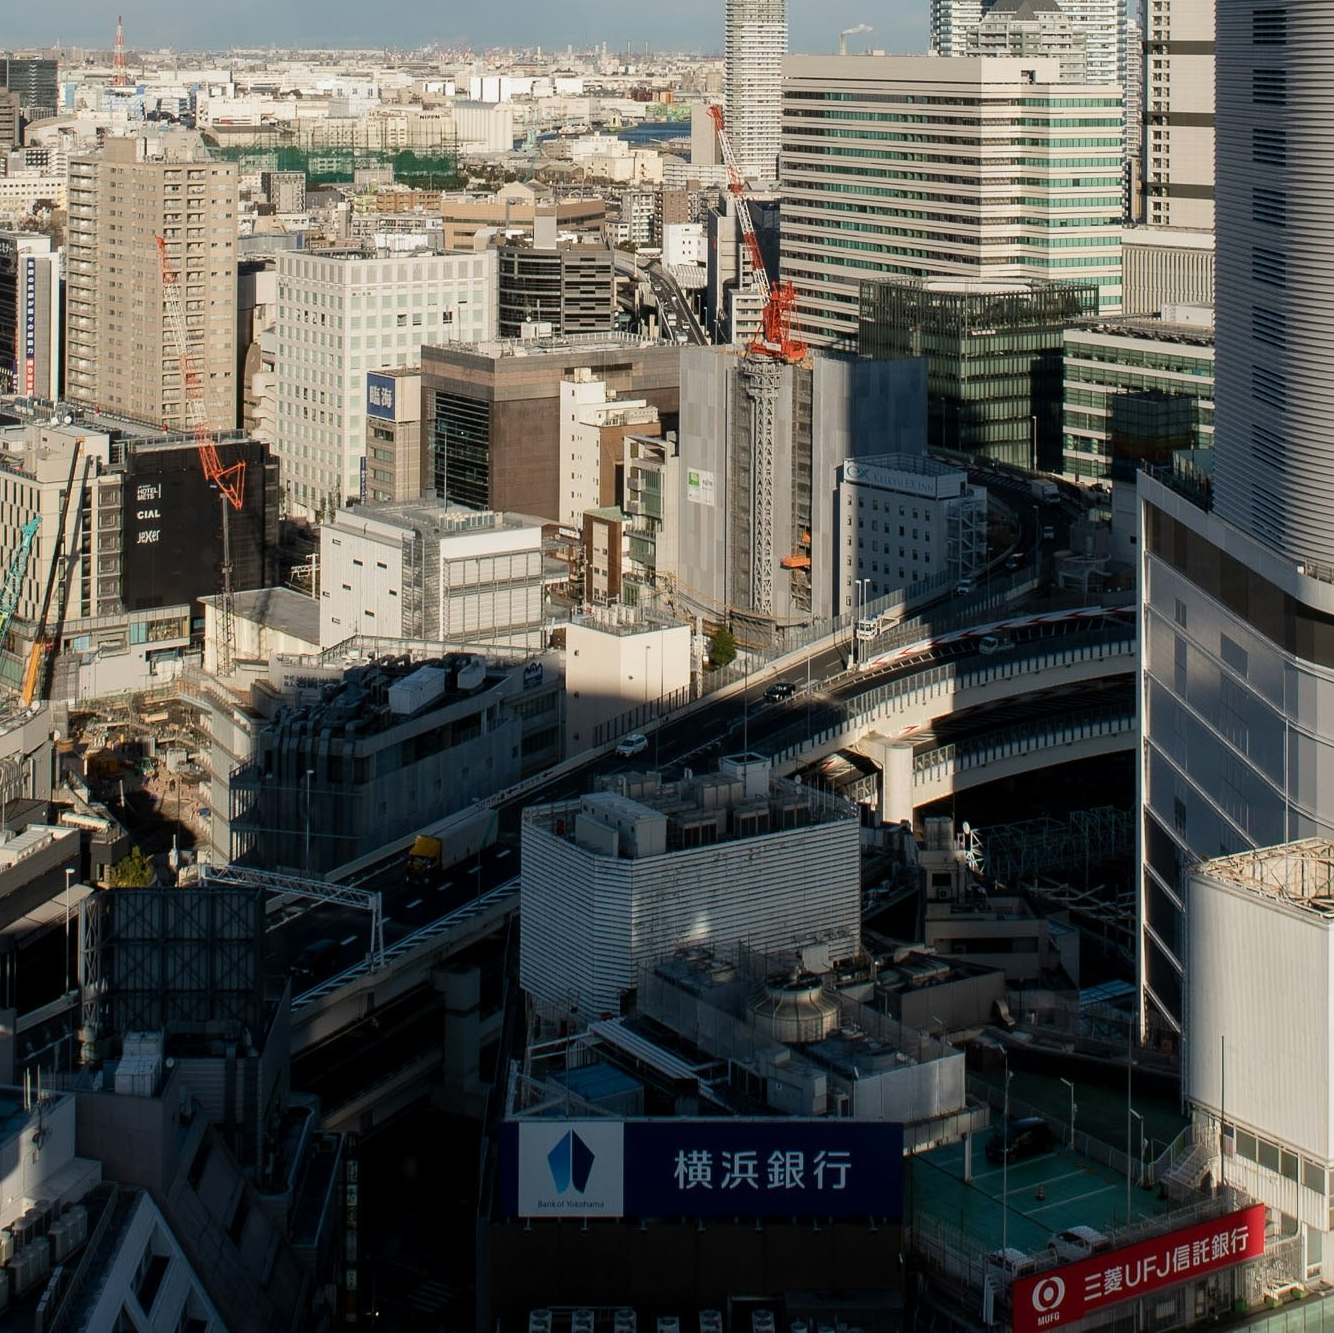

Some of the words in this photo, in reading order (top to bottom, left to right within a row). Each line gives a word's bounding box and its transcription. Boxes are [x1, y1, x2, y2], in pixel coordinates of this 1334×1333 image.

[369, 384, 393, 409] 臨海
[137, 487, 158, 495] HOTEL
[137, 509, 161, 520] CIAL
[673, 1149, 852, 1190] 横浜銀行
[538, 1199, 556, 1208] Bank
[557, 1199, 565, 1208] of
[566, 1199, 605, 1208] Yokohama
[1083, 1225, 1249, 1302] 三菱UFJ信託銀行
[1037, 1311, 1060, 1327] MUFG
